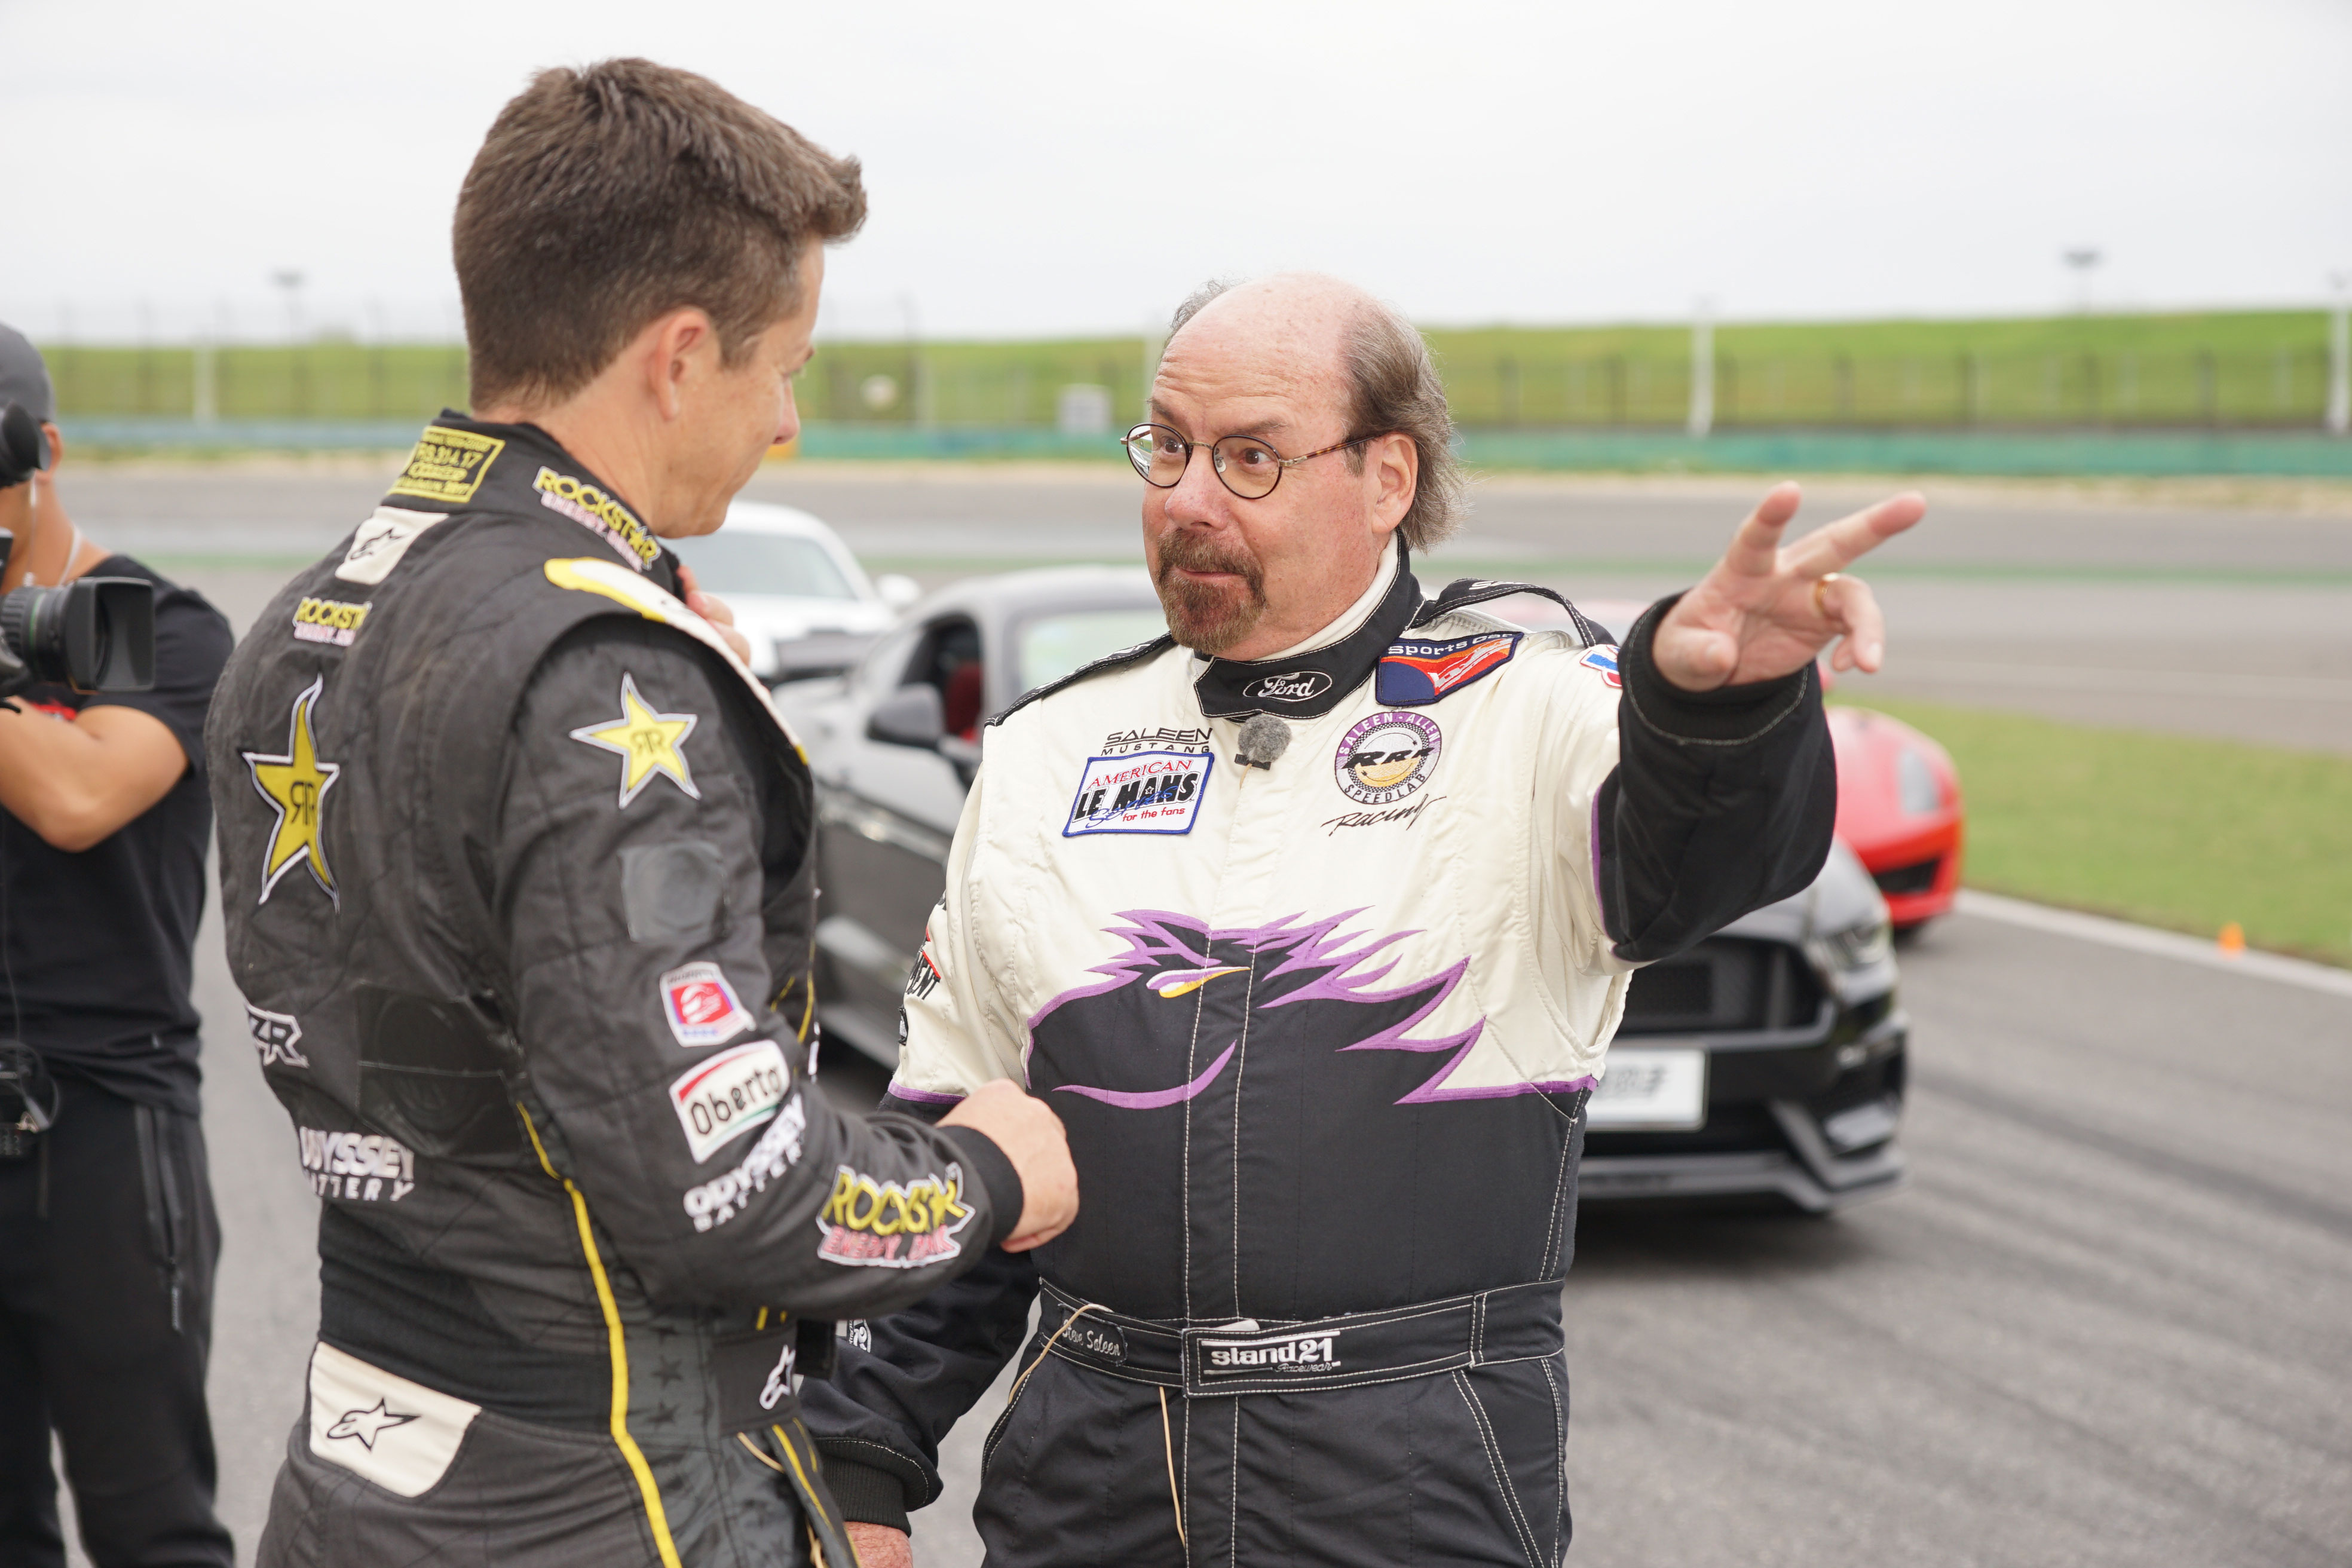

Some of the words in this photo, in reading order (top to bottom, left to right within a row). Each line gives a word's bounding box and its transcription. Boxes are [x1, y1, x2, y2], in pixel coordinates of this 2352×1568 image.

[1257, 672, 1315, 697] Ford
[1107, 727, 1213, 745] SALEEN
[1339, 713, 1393, 755] SALEEN
[1406, 713, 1440, 742] ALLEN
[1101, 742, 1211, 757] MUSTANG
[1087, 760, 1193, 790] AMERICAN
[1345, 773, 1426, 804] SPEEDLAB
[1073, 787, 1108, 822] LE
[1110, 772, 1201, 813] MANS
[1122, 813, 1138, 822] for
[1140, 808, 1158, 819] the
[1160, 807, 1186, 816] fans
[691, 1067, 783, 1135] Oberto
[692, 1135, 804, 1233] BATTER
[1086, 1330, 1121, 1356] Saleen
[1275, 1362, 1333, 1373] Racewear
